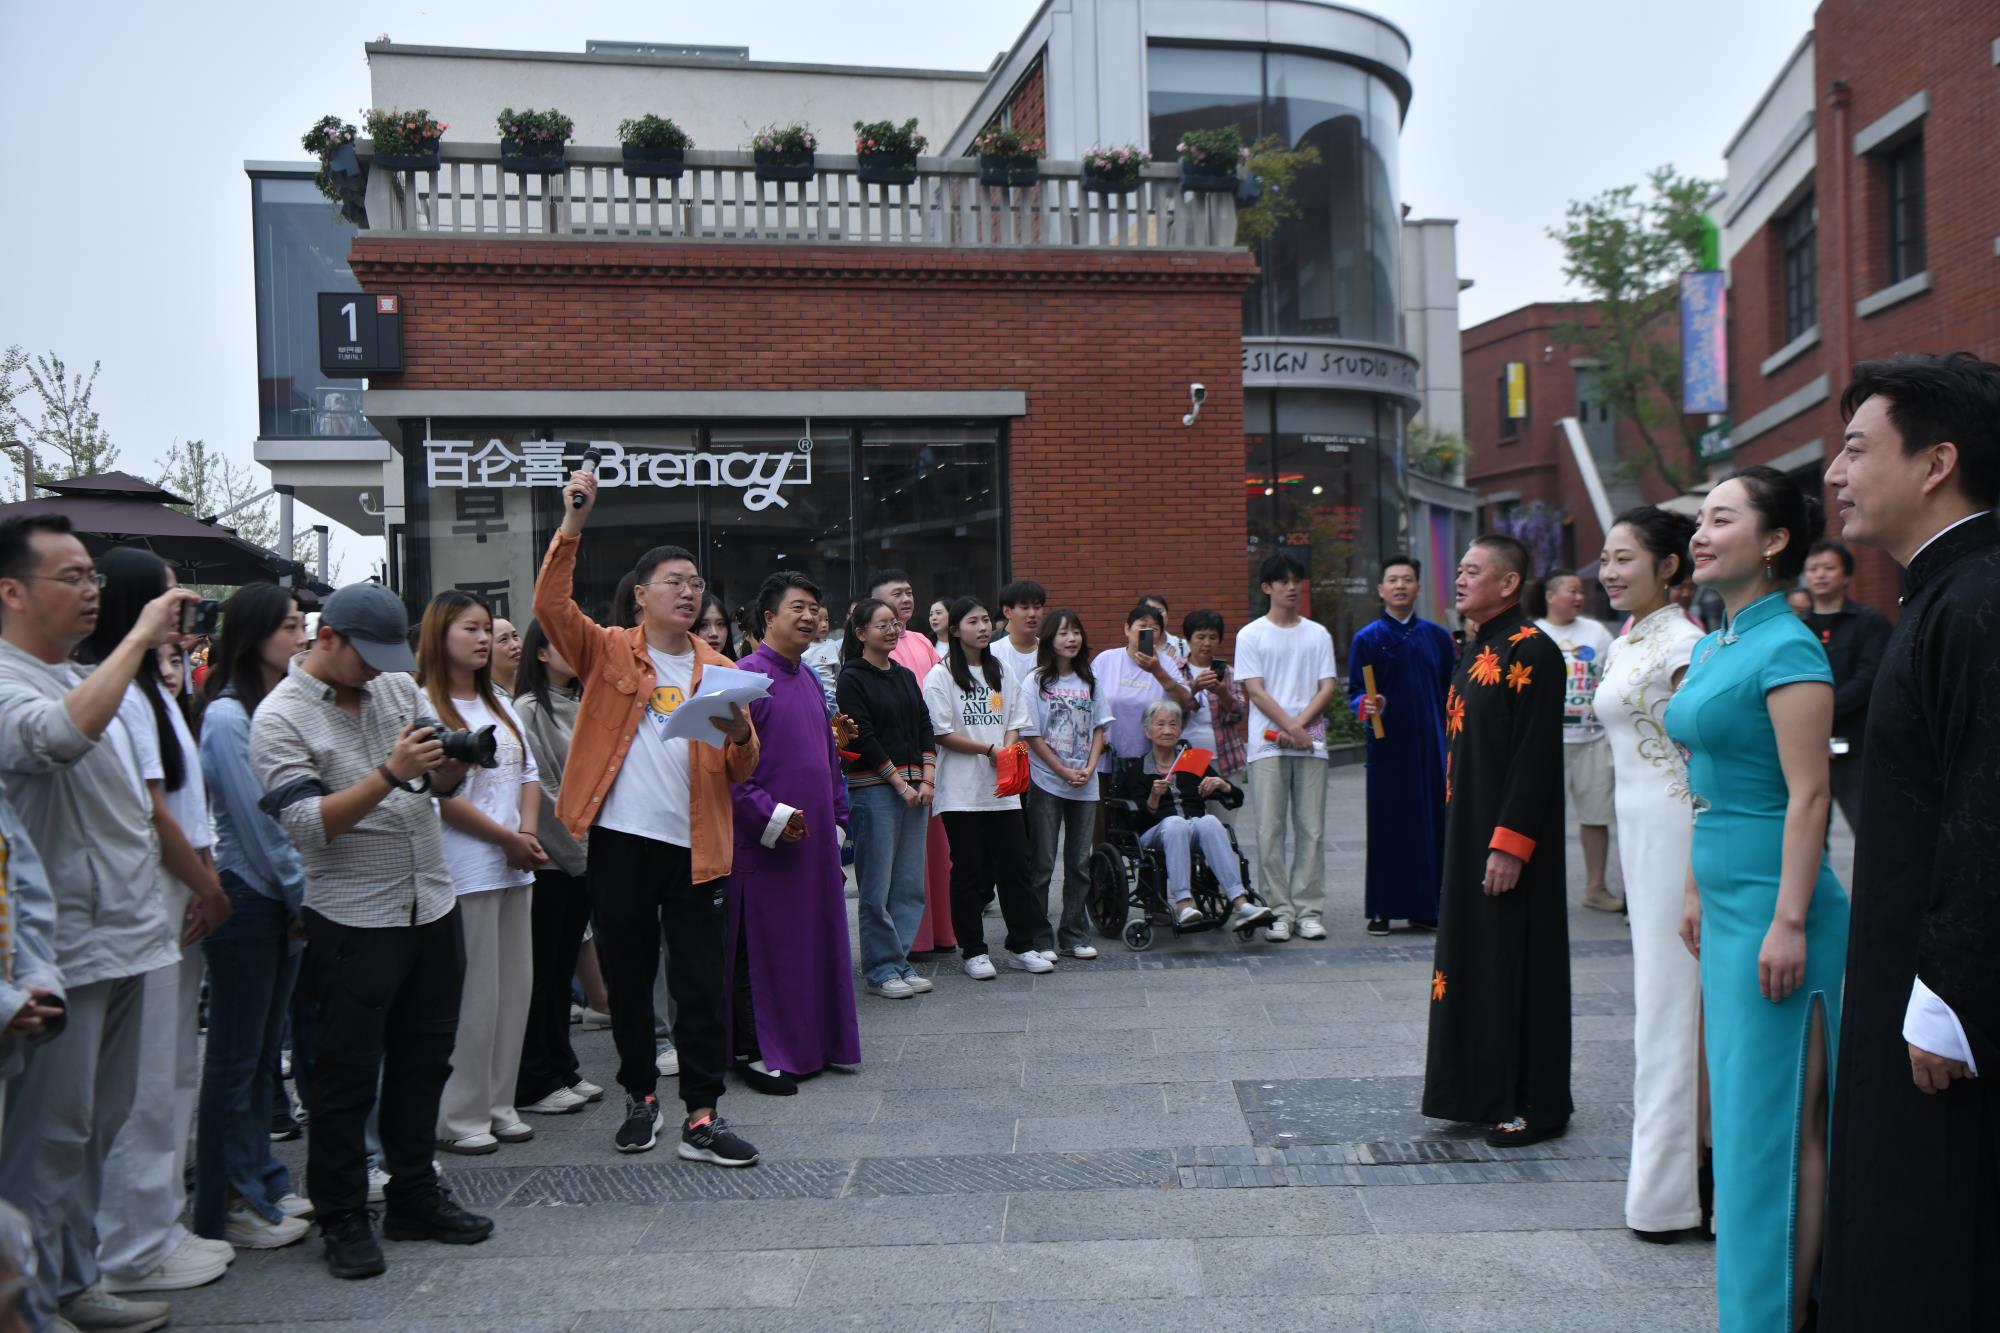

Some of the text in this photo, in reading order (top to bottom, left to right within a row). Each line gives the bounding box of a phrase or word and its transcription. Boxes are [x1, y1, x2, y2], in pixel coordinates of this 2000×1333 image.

[341, 302, 358, 342] 1
[1320, 353, 1387, 378] STUDIO
[423, 438, 568, 489] 百仑喜
[589, 440, 794, 512] Brency
[962, 714, 1004, 726] BEYON
